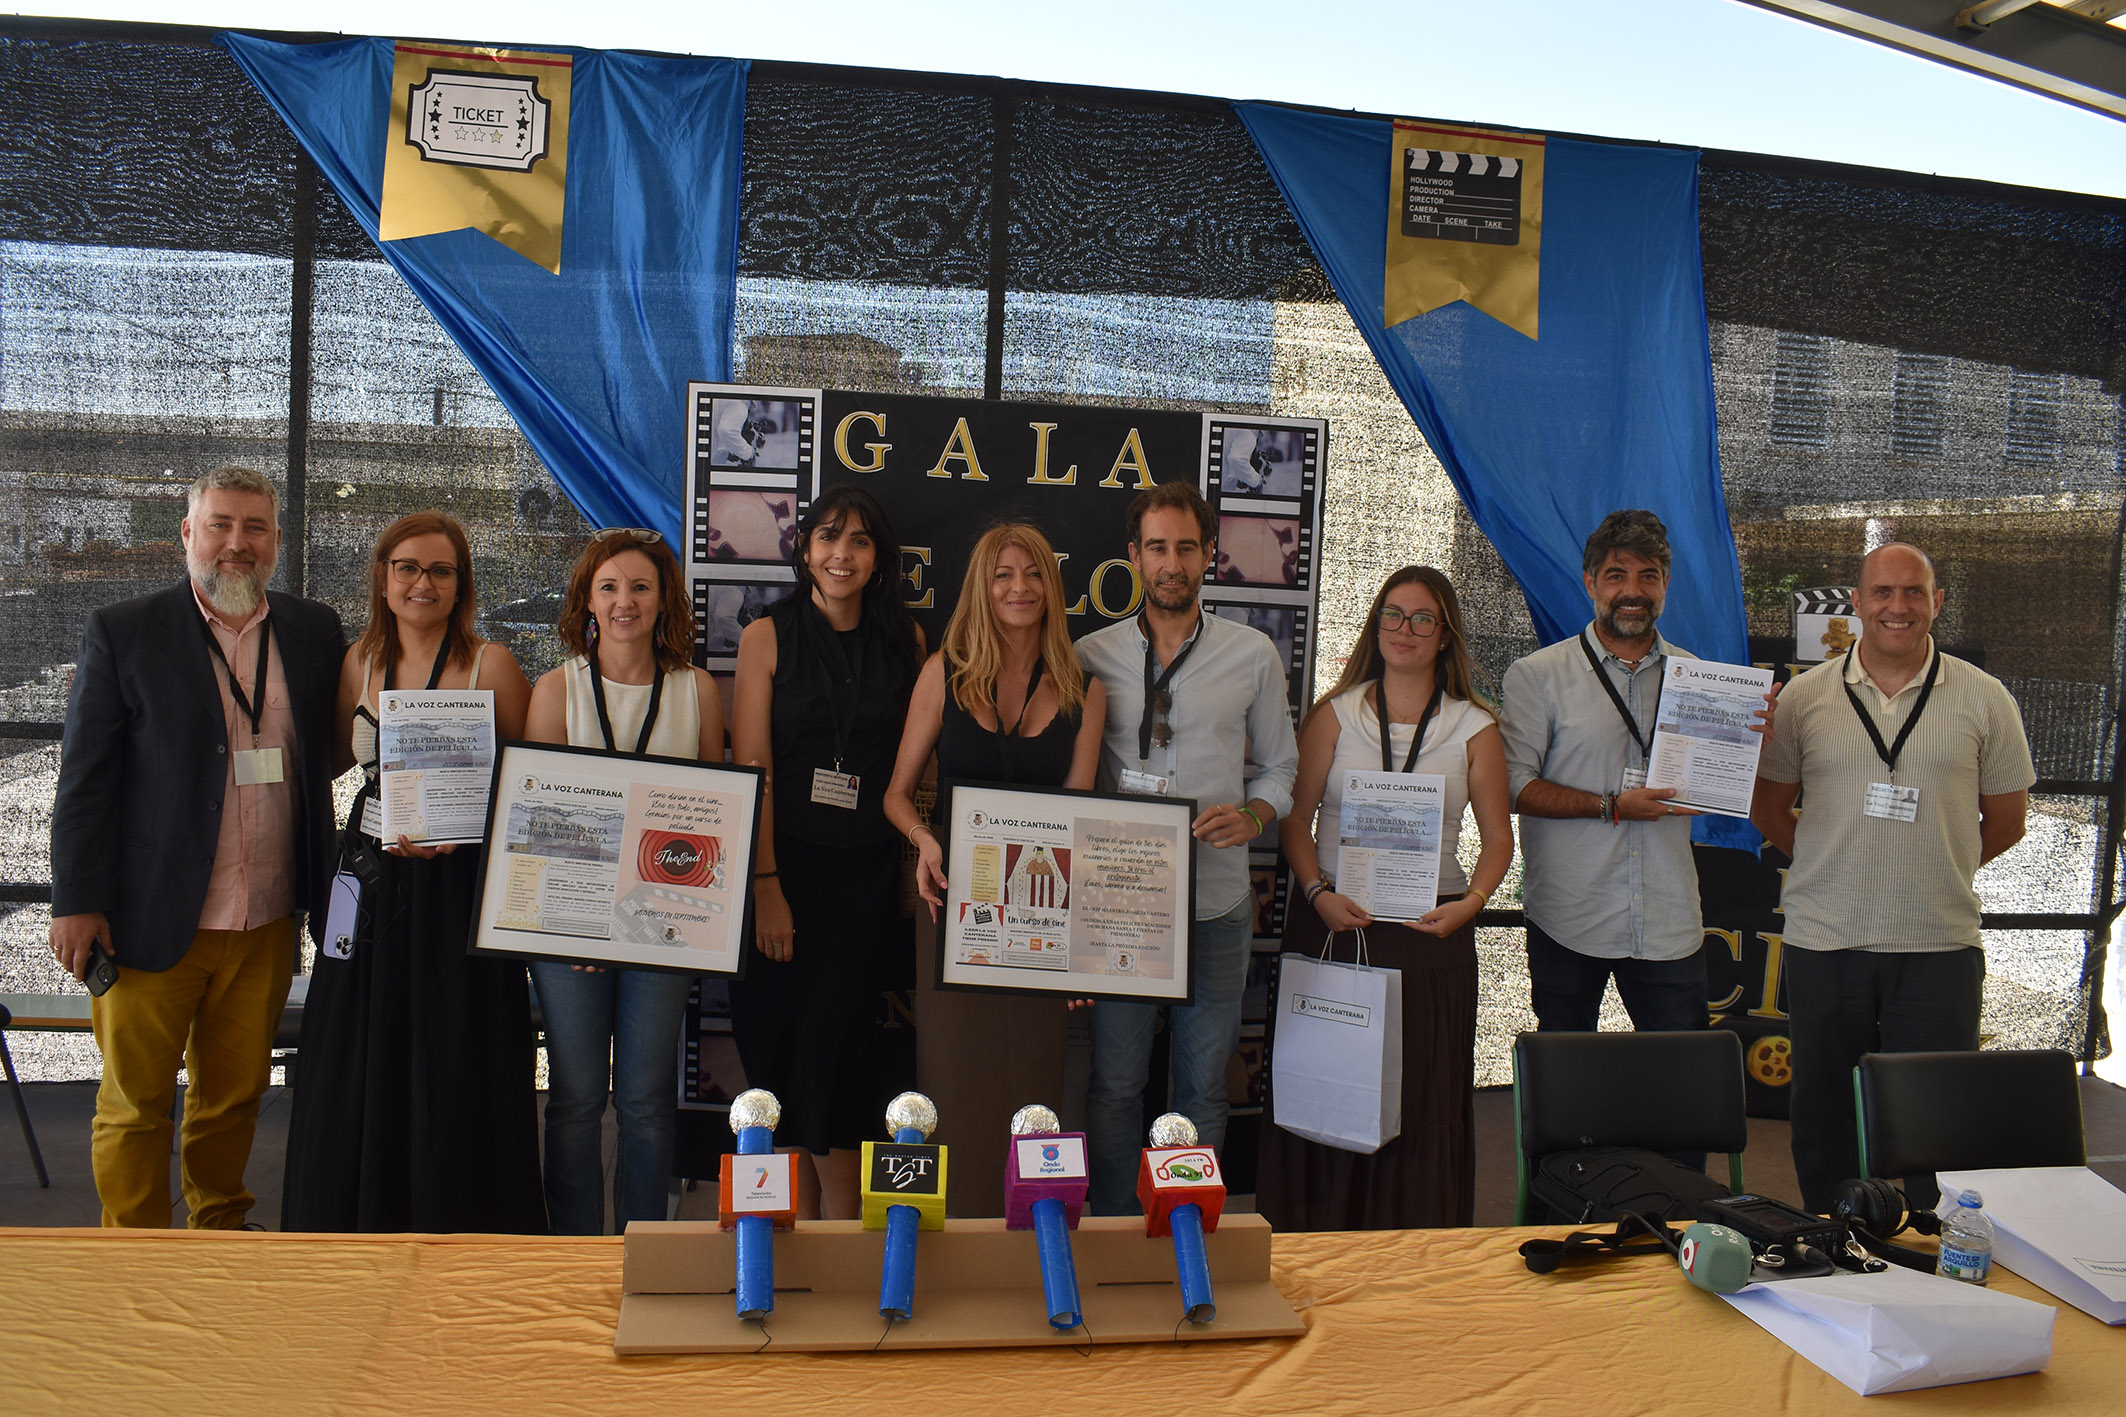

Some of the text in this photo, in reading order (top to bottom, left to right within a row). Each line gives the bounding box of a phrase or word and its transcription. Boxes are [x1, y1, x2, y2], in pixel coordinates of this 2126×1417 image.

[453, 106, 504, 122] TICKET
[1410, 176, 1453, 186] HOLLYWOOD
[1410, 186, 1455, 196] PRODUCTION
[1410, 196, 1444, 204] DIRECTOR
[1409, 205, 1438, 213] CAMERA
[1445, 217, 1468, 225] SCENE
[834, 410, 1158, 490] GALA
[1719, 675, 1764, 687] CANTERANA
[1668, 711, 1700, 720] EDICIÓN
[1698, 707, 1729, 716] PIERDAS
[390, 744, 424, 753] EDICIÓN
[573, 787, 623, 798] CANTERANA
[1393, 785, 1437, 793] CANTERANA
[648, 790, 666, 799] Como
[645, 809, 670, 819] Gracias
[694, 806, 719, 815] amigos!
[552, 823, 586, 832] PIERDAS
[588, 826, 608, 834] ESTA
[1021, 821, 1068, 831] CANTERANA
[518, 828, 552, 838] EDICIÓN
[1087, 834, 1109, 843] Prepara
[1113, 846, 1126, 855] elige
[1008, 916, 1018, 924] Un
[1042, 917, 1050, 927] de
[1052, 918, 1066, 927] cine
[1330, 1007, 1364, 1019] CANTERANA
[1944, 1247, 1970, 1261] FUENTE
[1944, 1256, 1979, 1267] ARQUILLO
